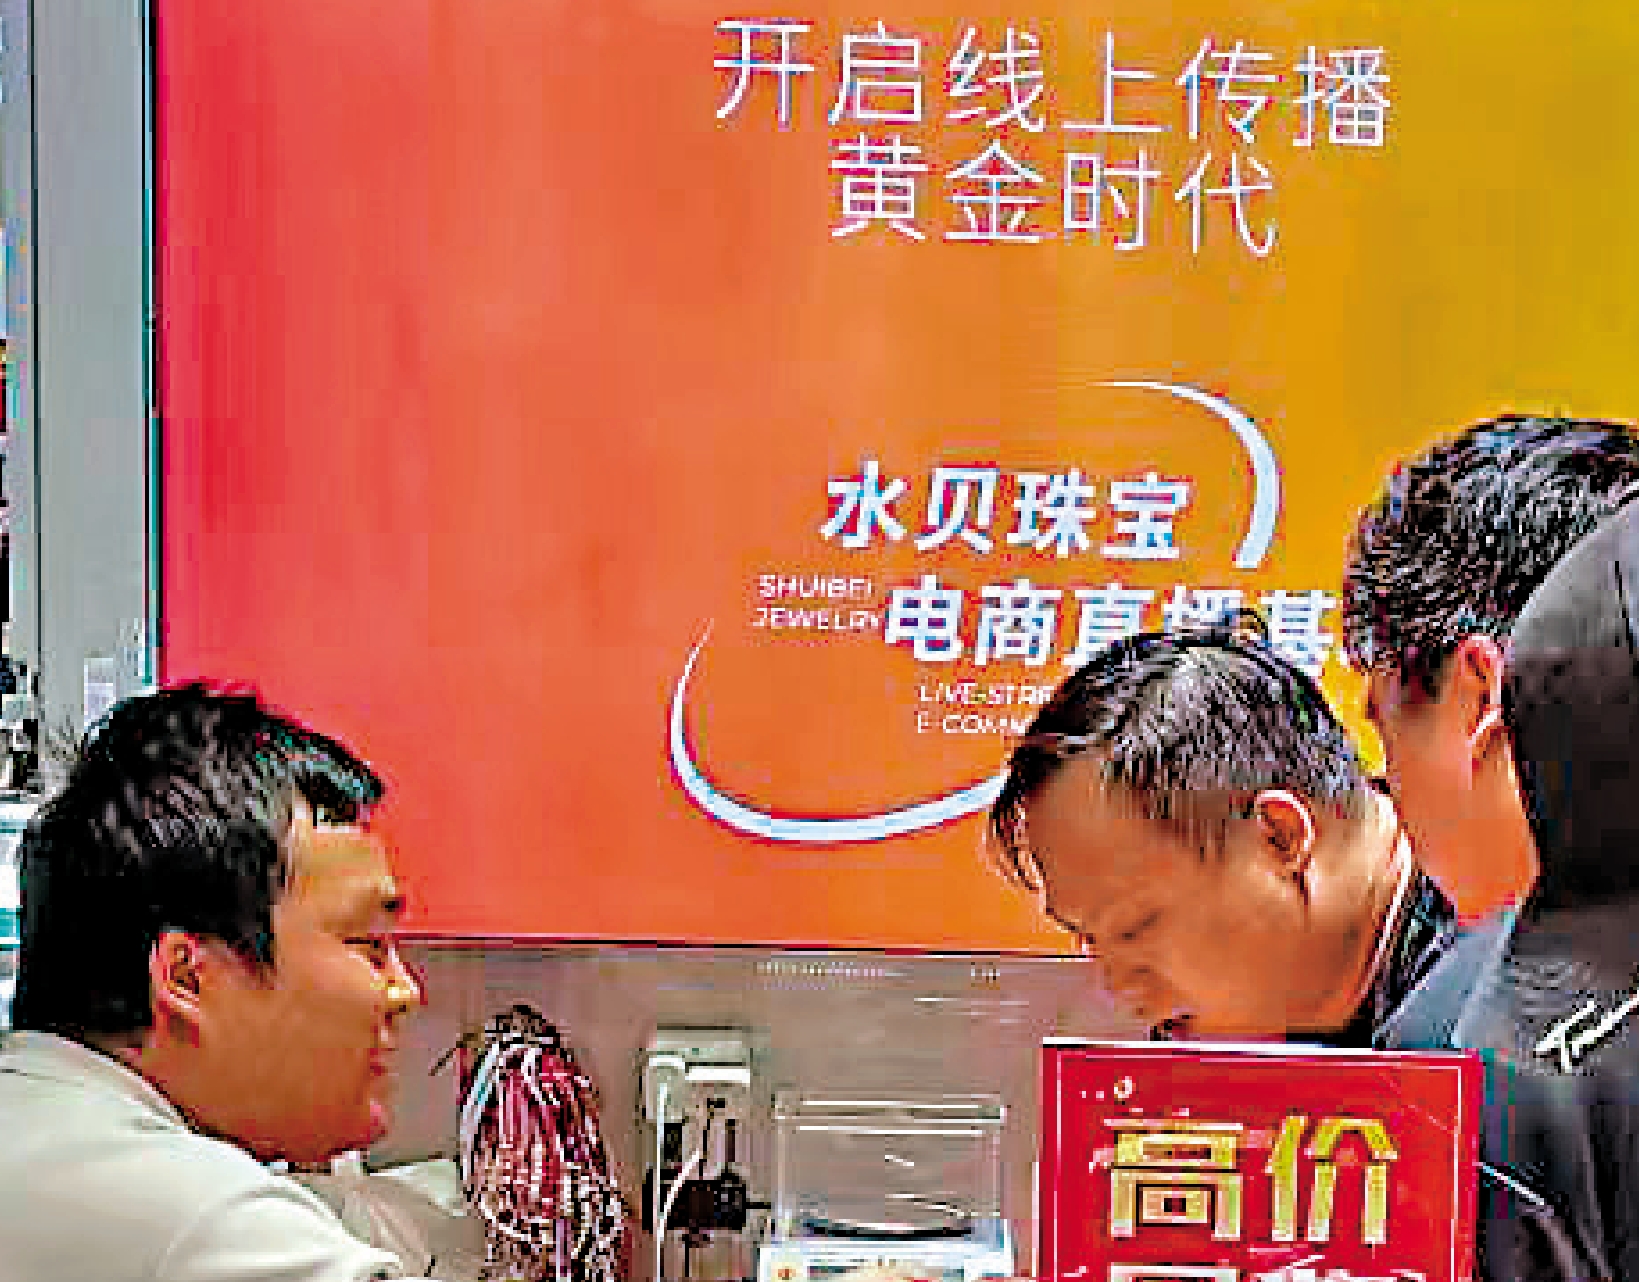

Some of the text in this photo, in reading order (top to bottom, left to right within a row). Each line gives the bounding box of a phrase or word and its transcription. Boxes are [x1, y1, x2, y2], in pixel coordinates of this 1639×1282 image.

[714, 16, 1392, 148] 开启线上传播
[829, 133, 1278, 258] 黄金时代
[818, 458, 1196, 562] 水贝珠宝
[1102, 1105, 1400, 1244] 高价
